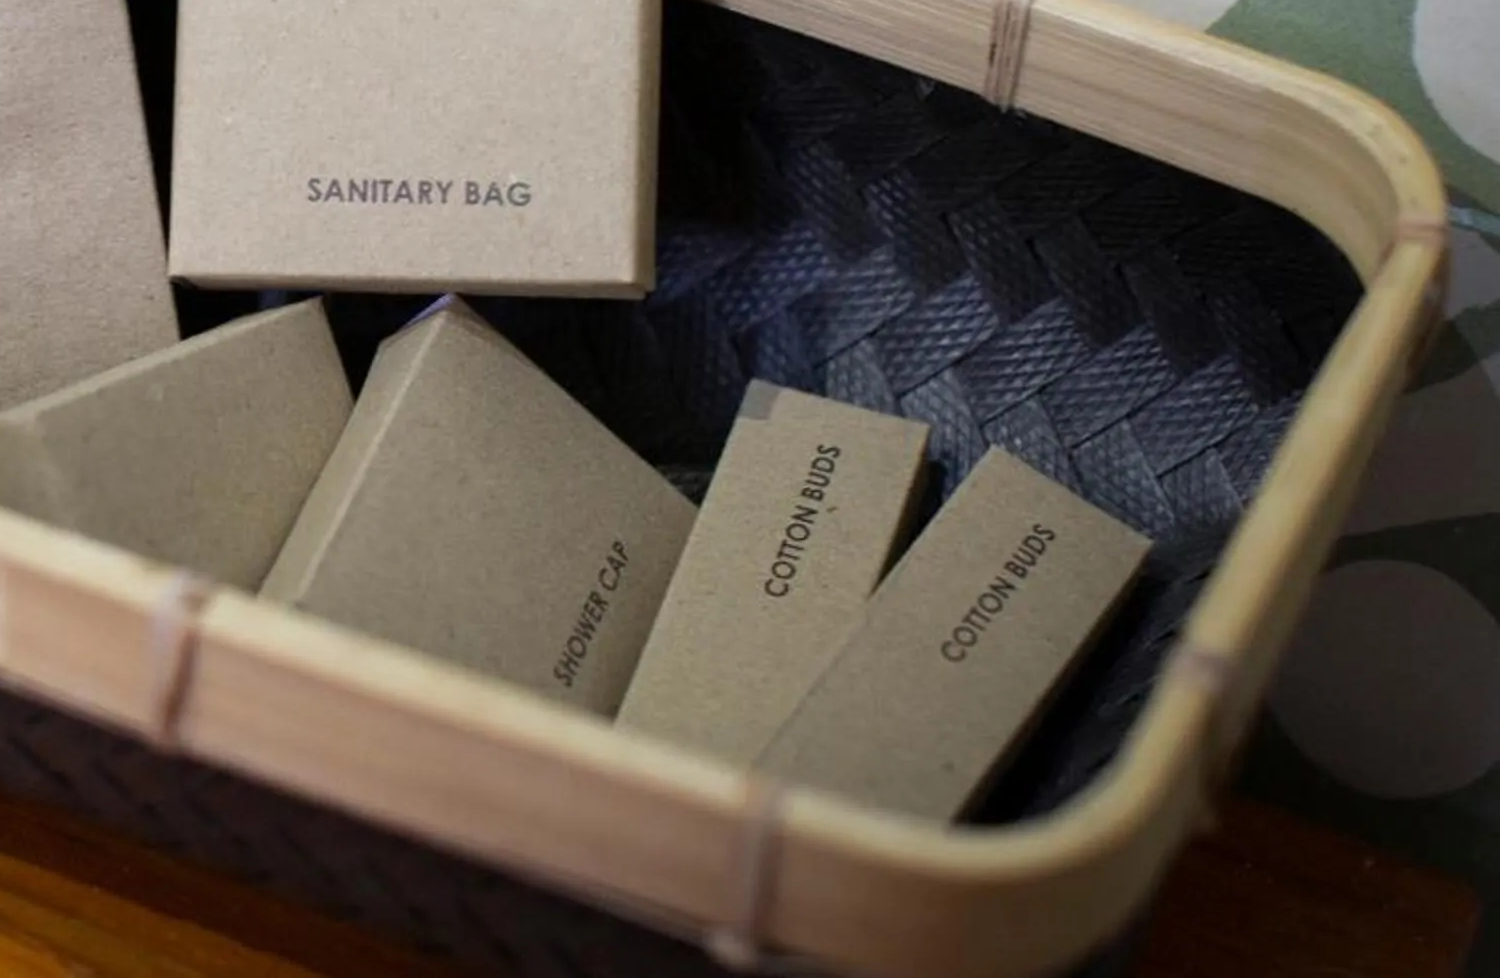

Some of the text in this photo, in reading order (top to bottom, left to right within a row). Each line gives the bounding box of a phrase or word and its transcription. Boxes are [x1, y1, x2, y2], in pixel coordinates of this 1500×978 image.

[307, 177, 532, 207] SANITARY BAG
[764, 444, 841, 598] COTTON BUDS
[553, 540, 629, 687] SHOWER CAP
[940, 523, 1057, 663] COTTON BUDS
